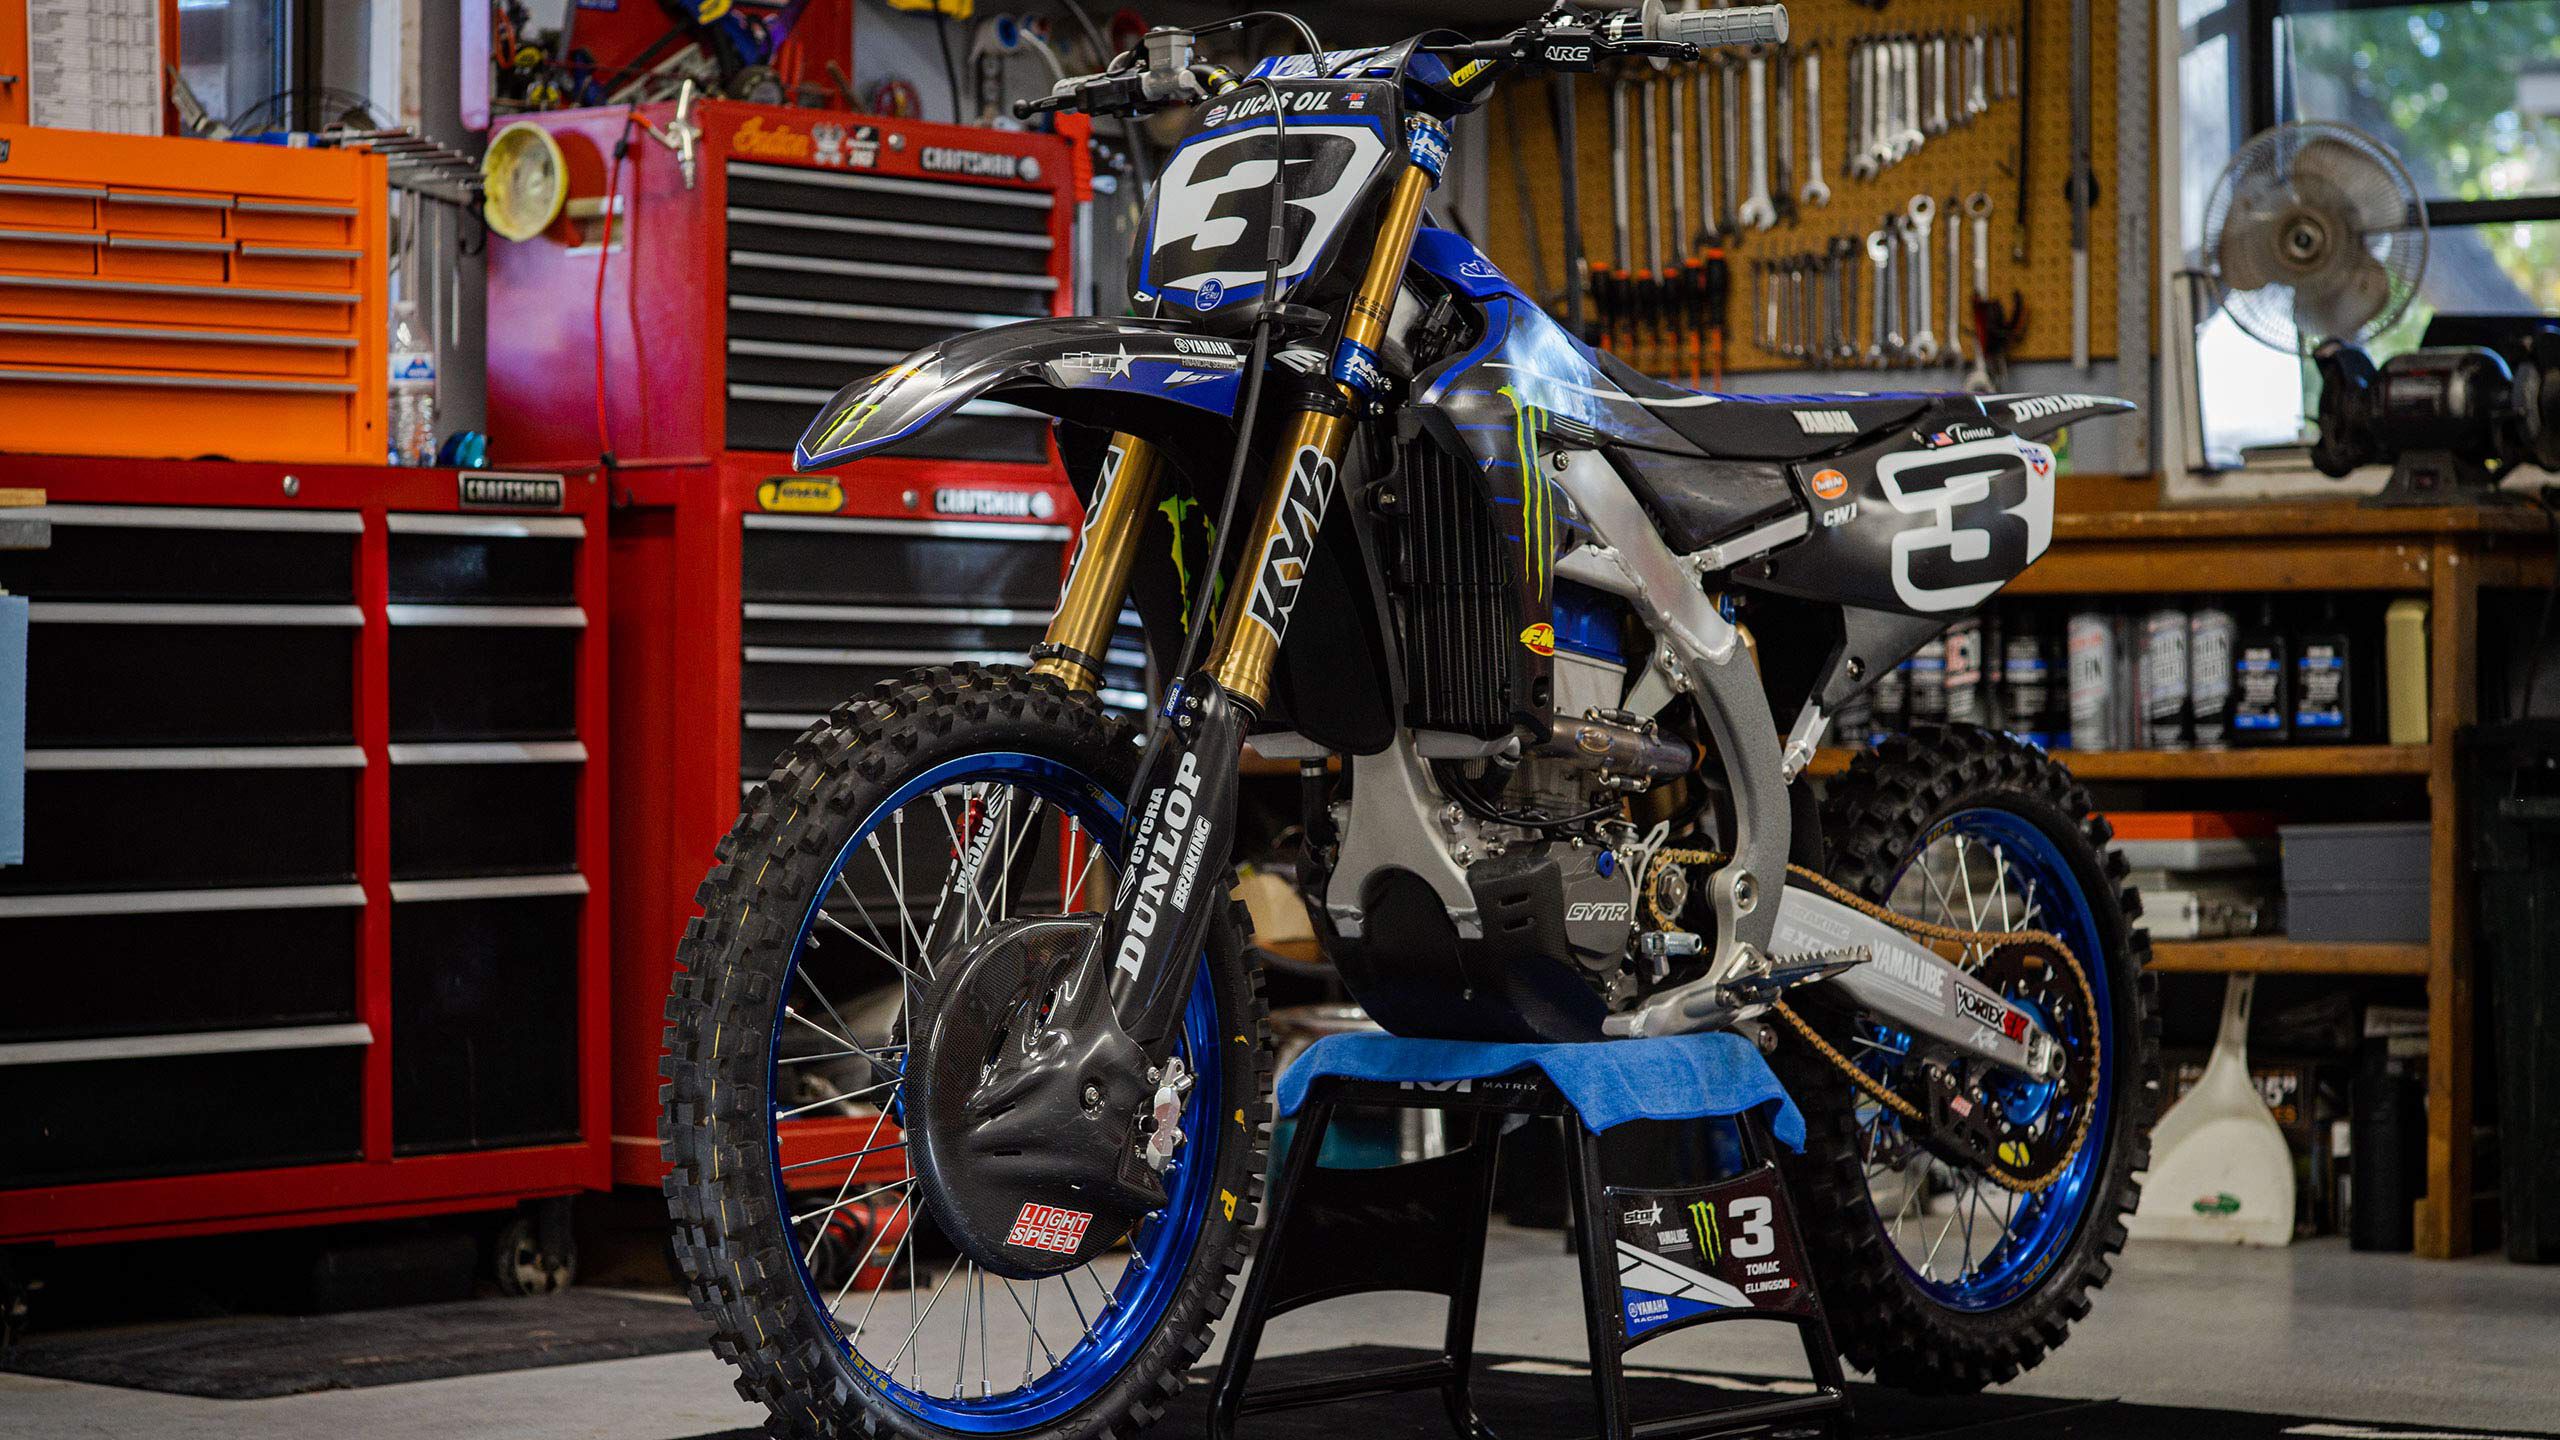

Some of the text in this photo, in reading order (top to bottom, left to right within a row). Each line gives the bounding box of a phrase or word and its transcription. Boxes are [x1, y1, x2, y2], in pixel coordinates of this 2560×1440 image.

[1545, 47, 1589, 61] ARC
[1293, 92, 1332, 111] OIL
[921, 147, 1018, 177] CRAFTSMAN
[1150, 126, 1385, 290] 3
[1188, 339, 1234, 356] YAMAHA
[1182, 358, 1211, 368] FINANCIAL
[2008, 396, 2094, 423] DUNLOP
[1793, 410, 1858, 433] YAMAHA
[1945, 423, 1995, 444] Tomac
[467, 480, 557, 500] CRAFTSMAN
[936, 488, 1029, 515] CRAFTSMAN
[1876, 436, 2056, 612] 3
[1246, 444, 1337, 649] KYB
[1520, 627, 1555, 648] FM
[1130, 787, 1166, 865] CYCRA
[1115, 751, 1202, 982] DUNLOP
[1171, 815, 1212, 912] BRAKING
[1565, 902, 1630, 921] GYTR
[1872, 938, 1947, 997] YAMALUBE
[1955, 983, 2006, 1028] VORTEX
[1482, 1081, 1537, 1091] MATRIX
[1020, 1206, 1089, 1234] LIGHT
[1728, 1196, 1775, 1259] 3
[1011, 1227, 1080, 1250] SPEED
[1745, 1261, 1780, 1276] TOMAC
[1745, 1278, 1790, 1294] ELLINGSON
[1634, 1313, 1669, 1324] RACING
[1637, 1299, 1669, 1315] YAMAHA
[849, 1346, 889, 1391] EXCEL
